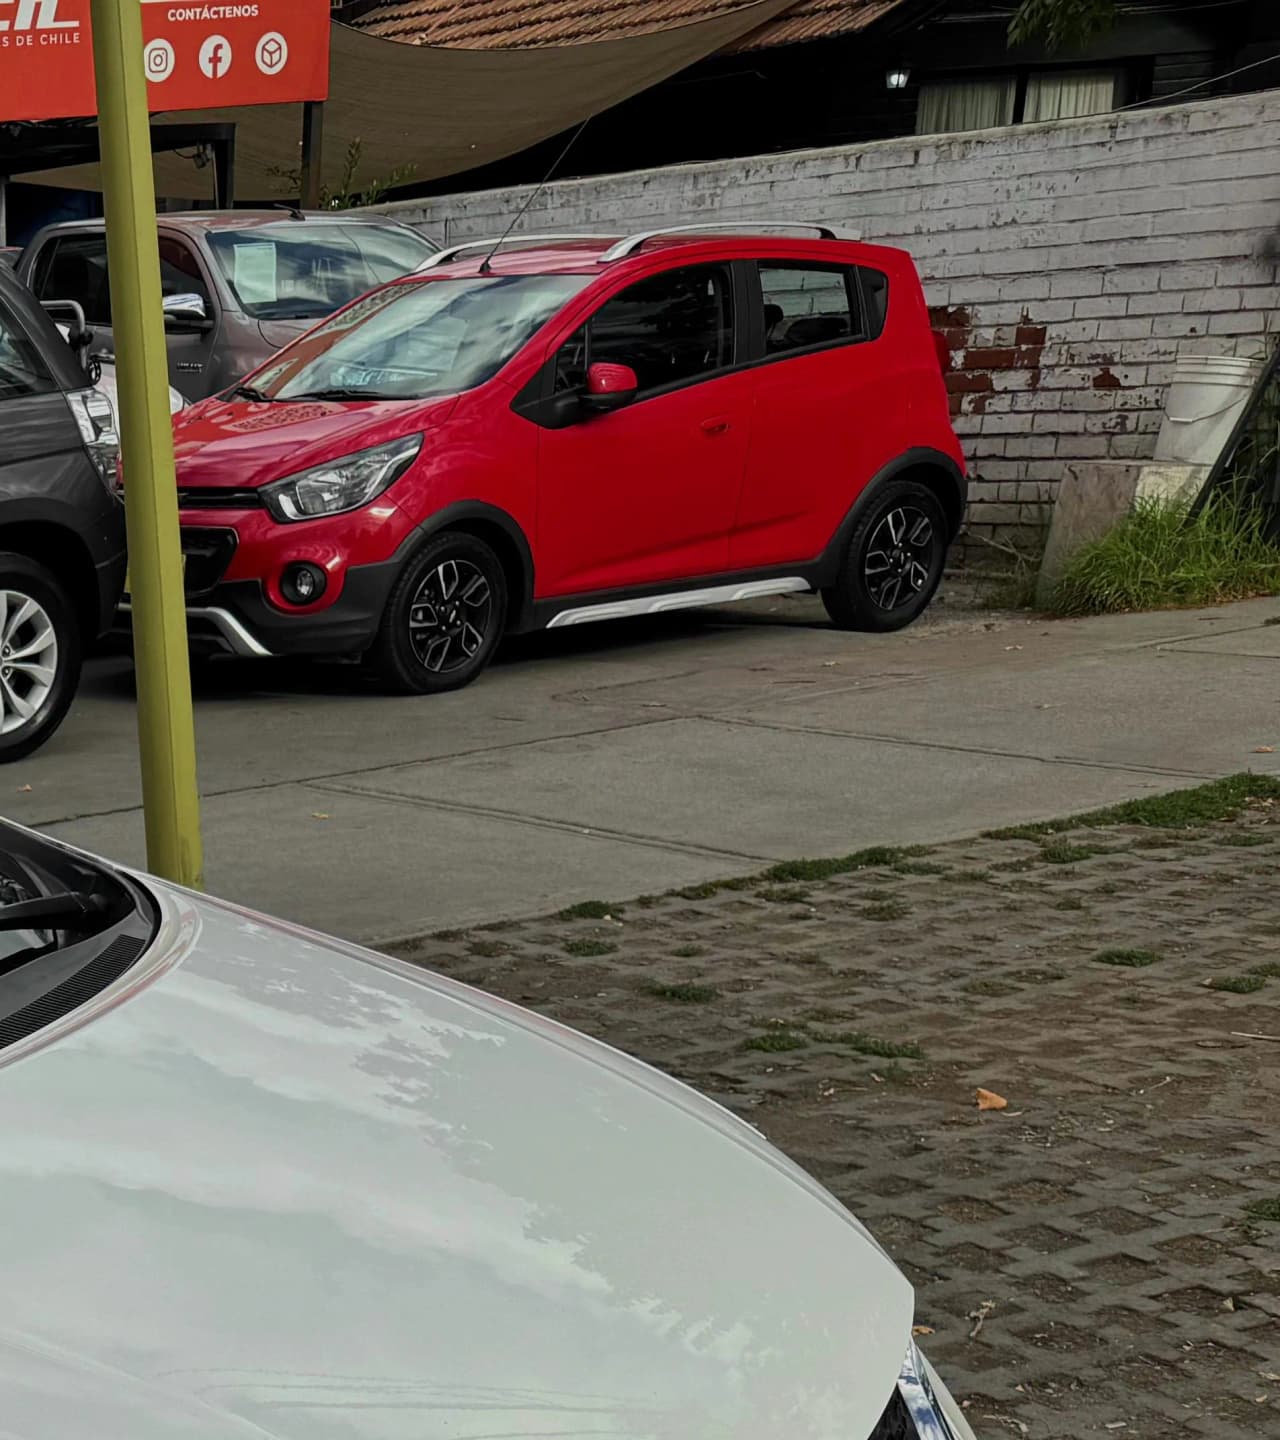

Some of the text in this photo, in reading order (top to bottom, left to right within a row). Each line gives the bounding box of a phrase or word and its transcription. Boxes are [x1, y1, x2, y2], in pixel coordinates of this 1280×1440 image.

[168, 5, 259, 21] CONTÁCTENOS
[16, 35, 33, 47] DE
[40, 32, 80, 46] CHILE
